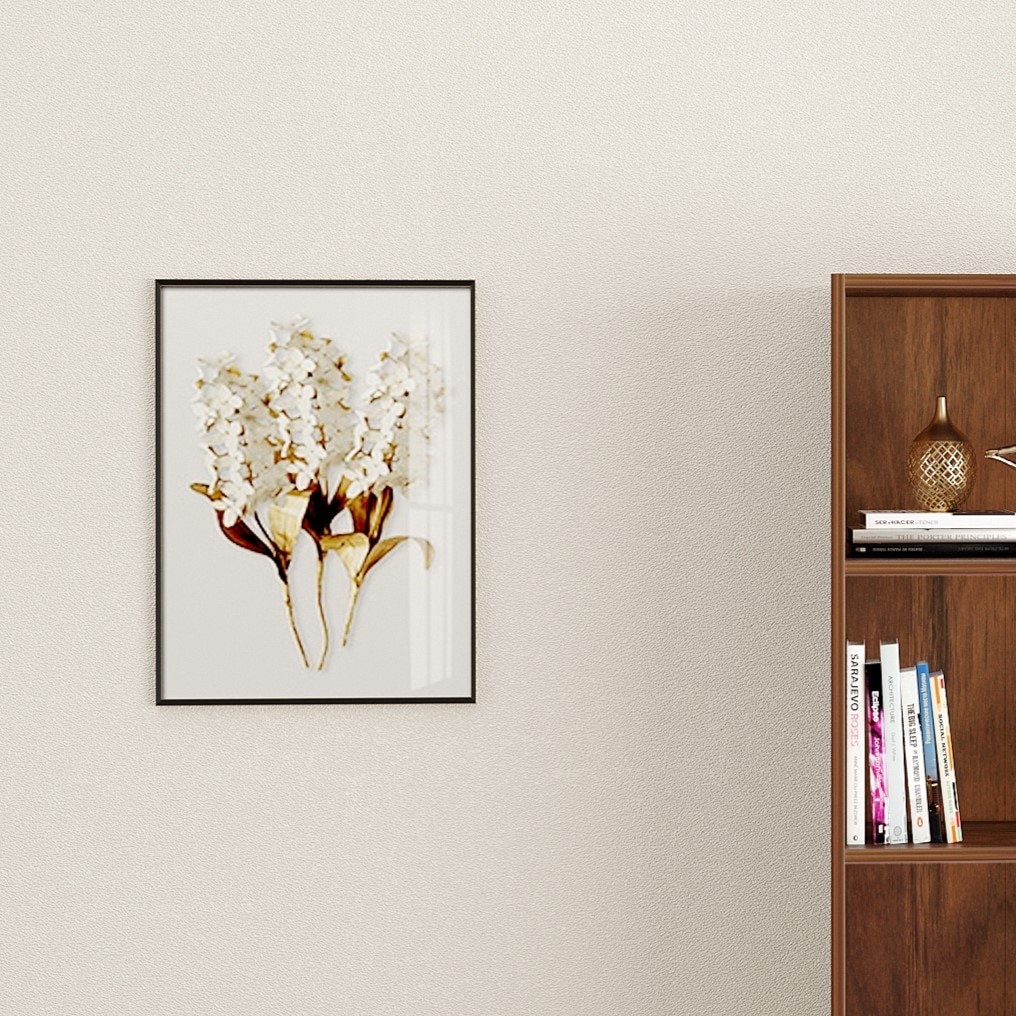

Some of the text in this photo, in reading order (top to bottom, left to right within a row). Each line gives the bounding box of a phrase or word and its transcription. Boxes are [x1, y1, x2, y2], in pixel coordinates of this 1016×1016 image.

[850, 654, 859, 747] SARAJEVO ROSES
[871, 690, 880, 722] Eclipse
[907, 703, 915, 716] THE
[907, 716, 916, 728] BIG
[908, 728, 917, 748] SLEEP
[941, 742, 949, 777] NETWORK
